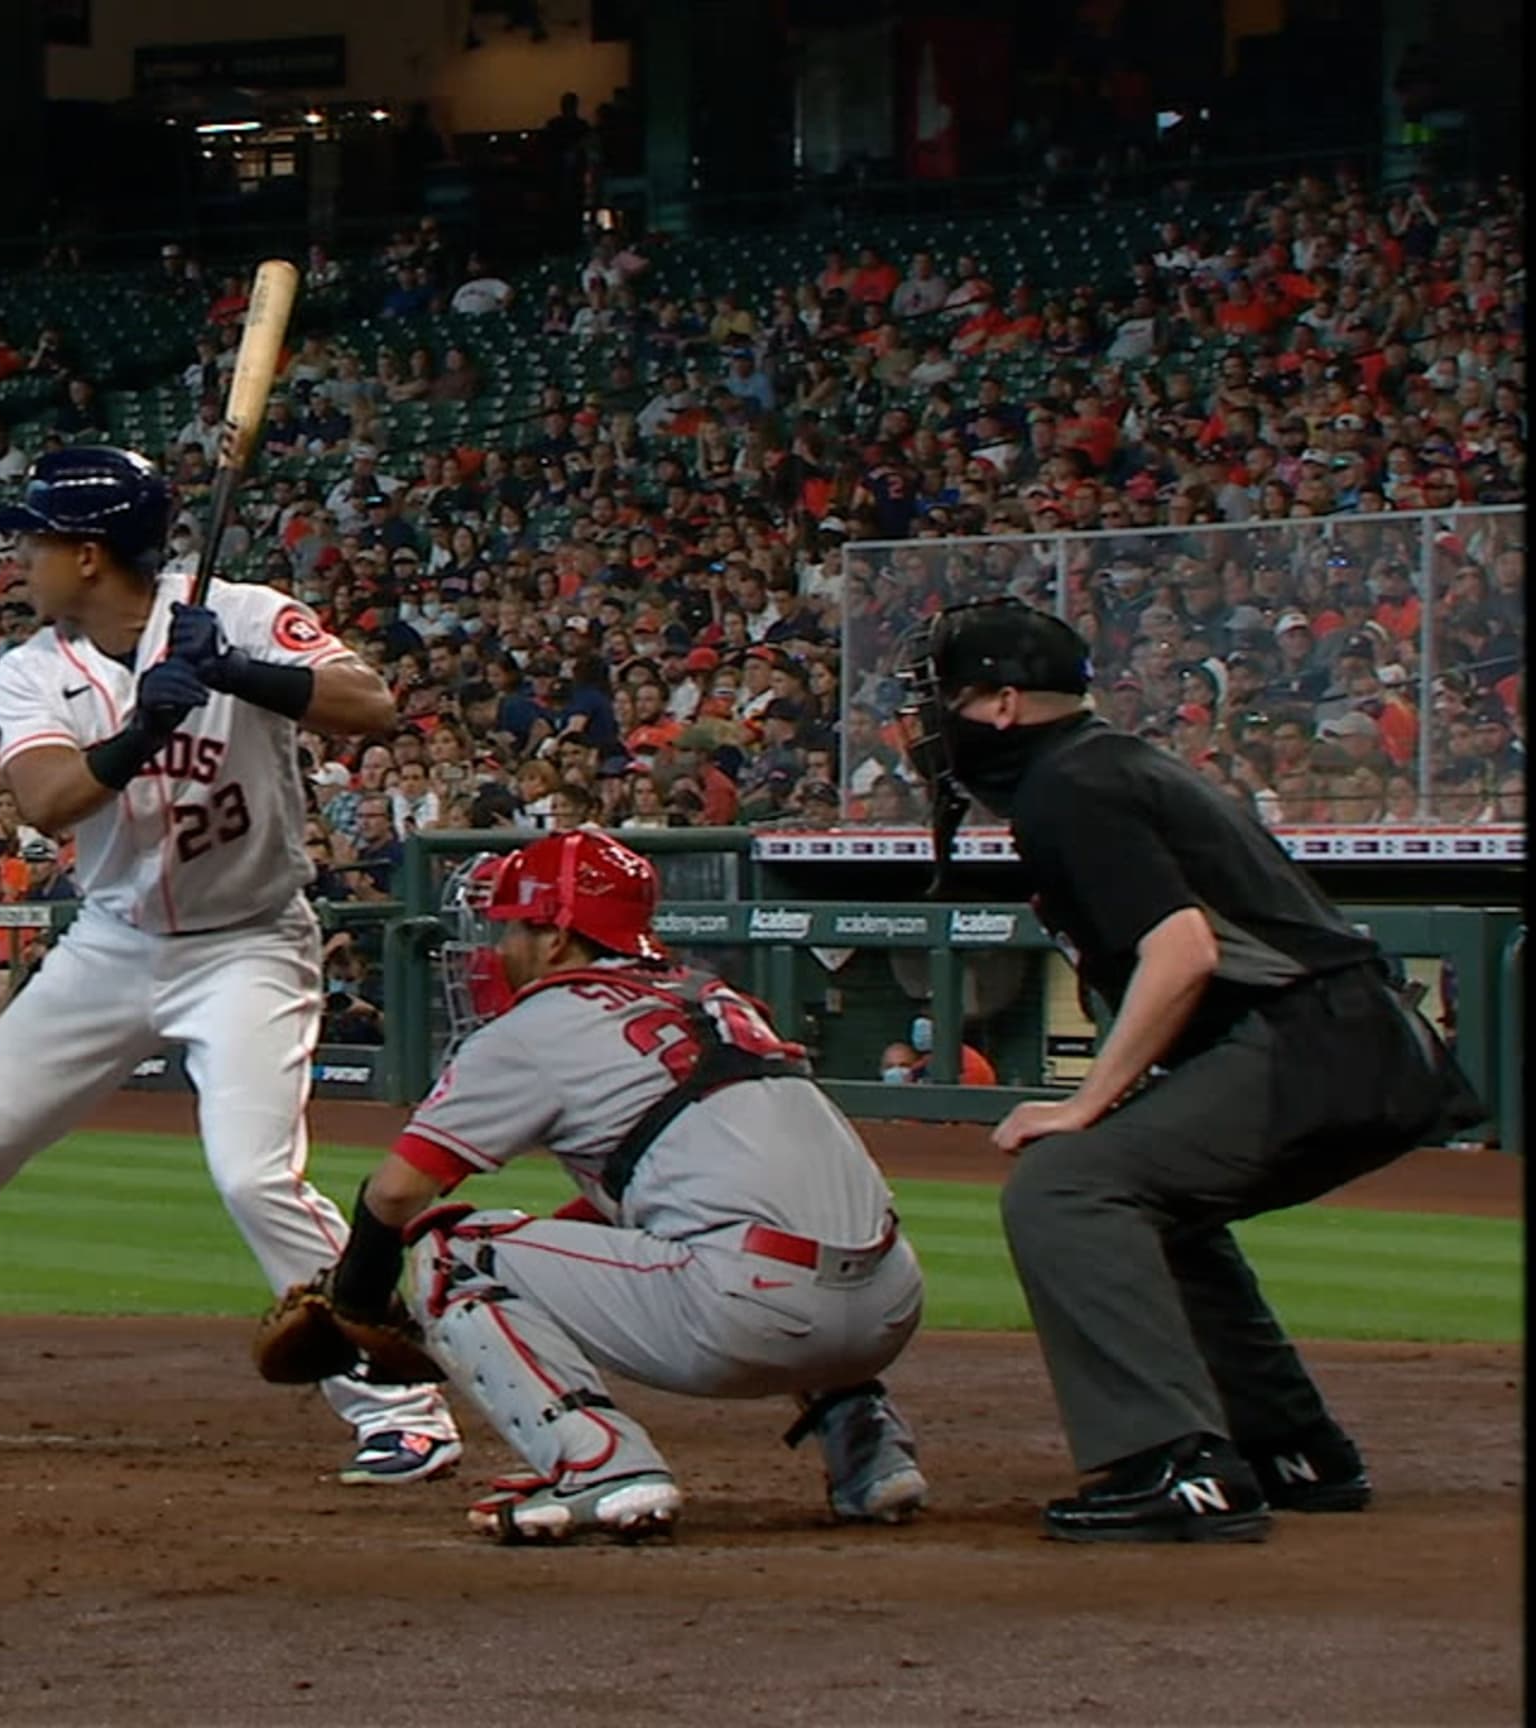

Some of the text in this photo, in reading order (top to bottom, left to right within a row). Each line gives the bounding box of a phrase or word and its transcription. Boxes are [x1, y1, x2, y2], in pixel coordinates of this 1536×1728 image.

[174, 782, 252, 863] 23
[749, 908, 812, 932] Academy
[835, 913, 928, 938] academy.com
[950, 910, 1017, 935] Academy
[1273, 1451, 1319, 1484] N
[1175, 1476, 1231, 1514] N
